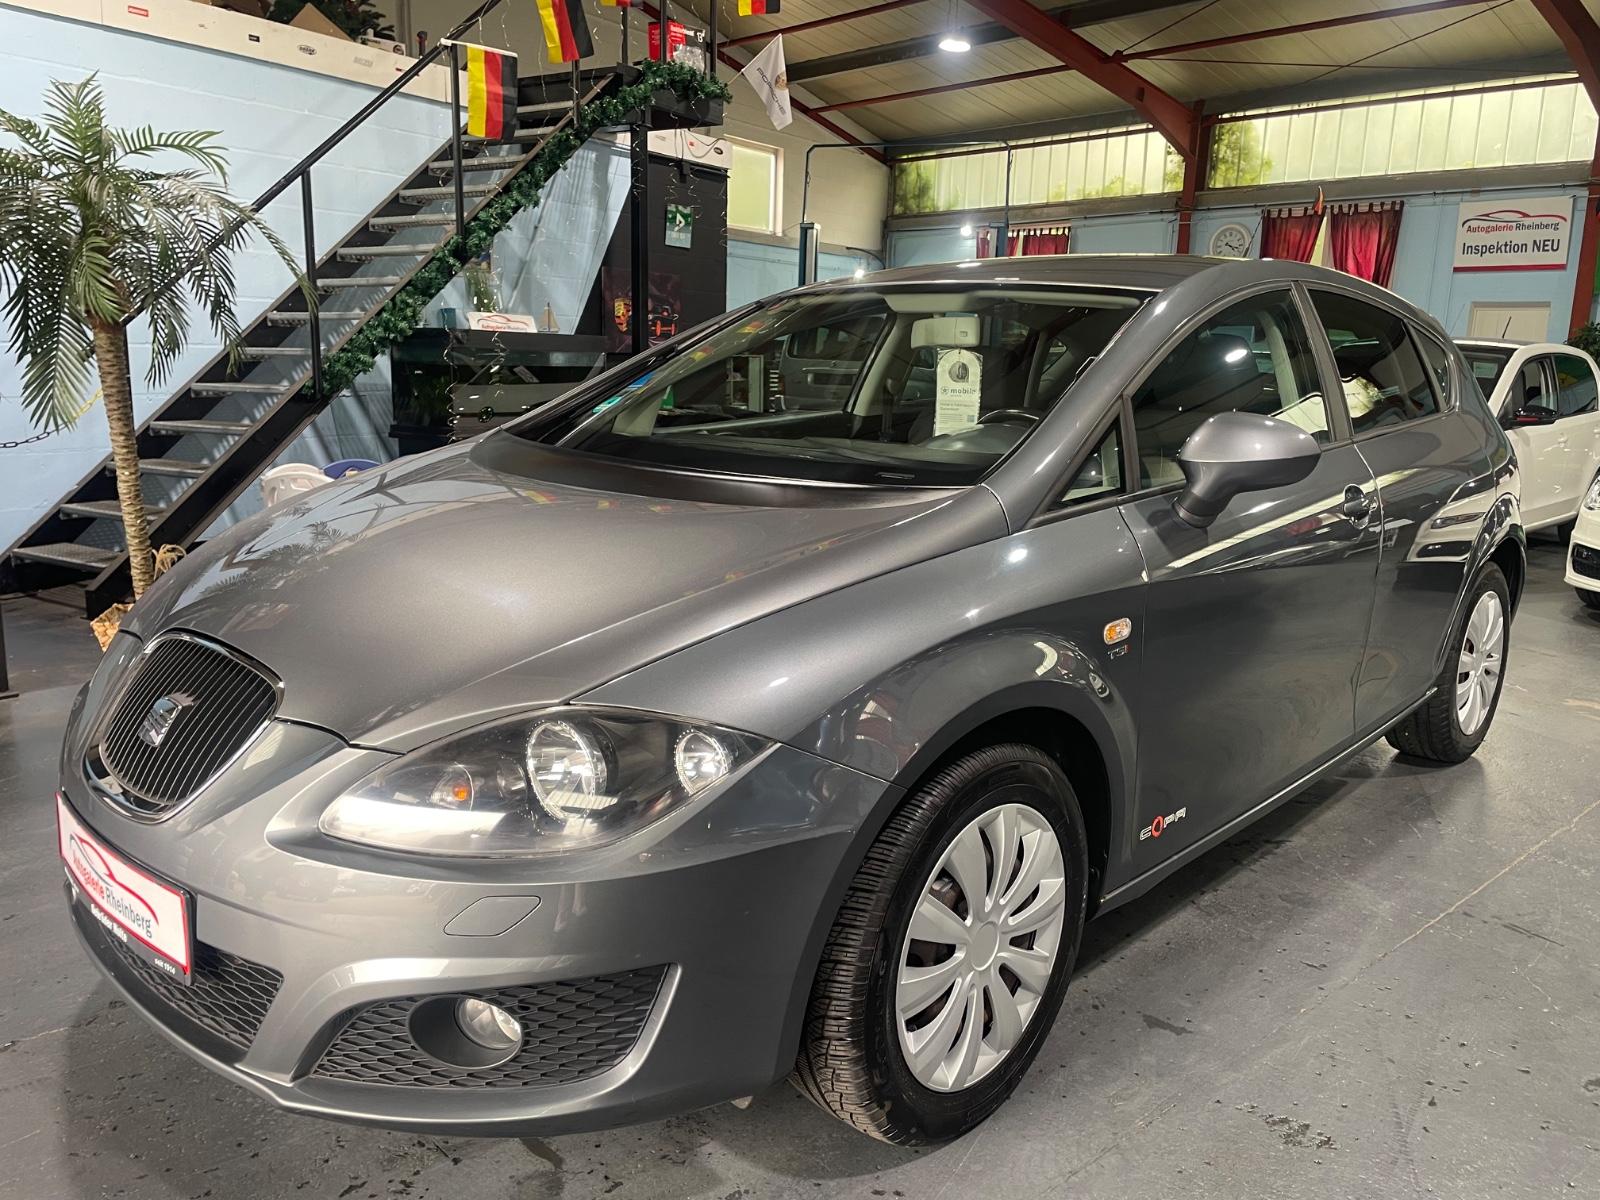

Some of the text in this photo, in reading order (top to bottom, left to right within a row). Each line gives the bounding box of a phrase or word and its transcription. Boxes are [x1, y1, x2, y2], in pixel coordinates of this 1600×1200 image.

[757, 67, 787, 115] PORSCHE
[1466, 221, 1560, 233] Autogalerie Rheinberg
[1462, 238, 1561, 257] Inspektion NEU
[105, 888, 152, 938] Rheinberg
